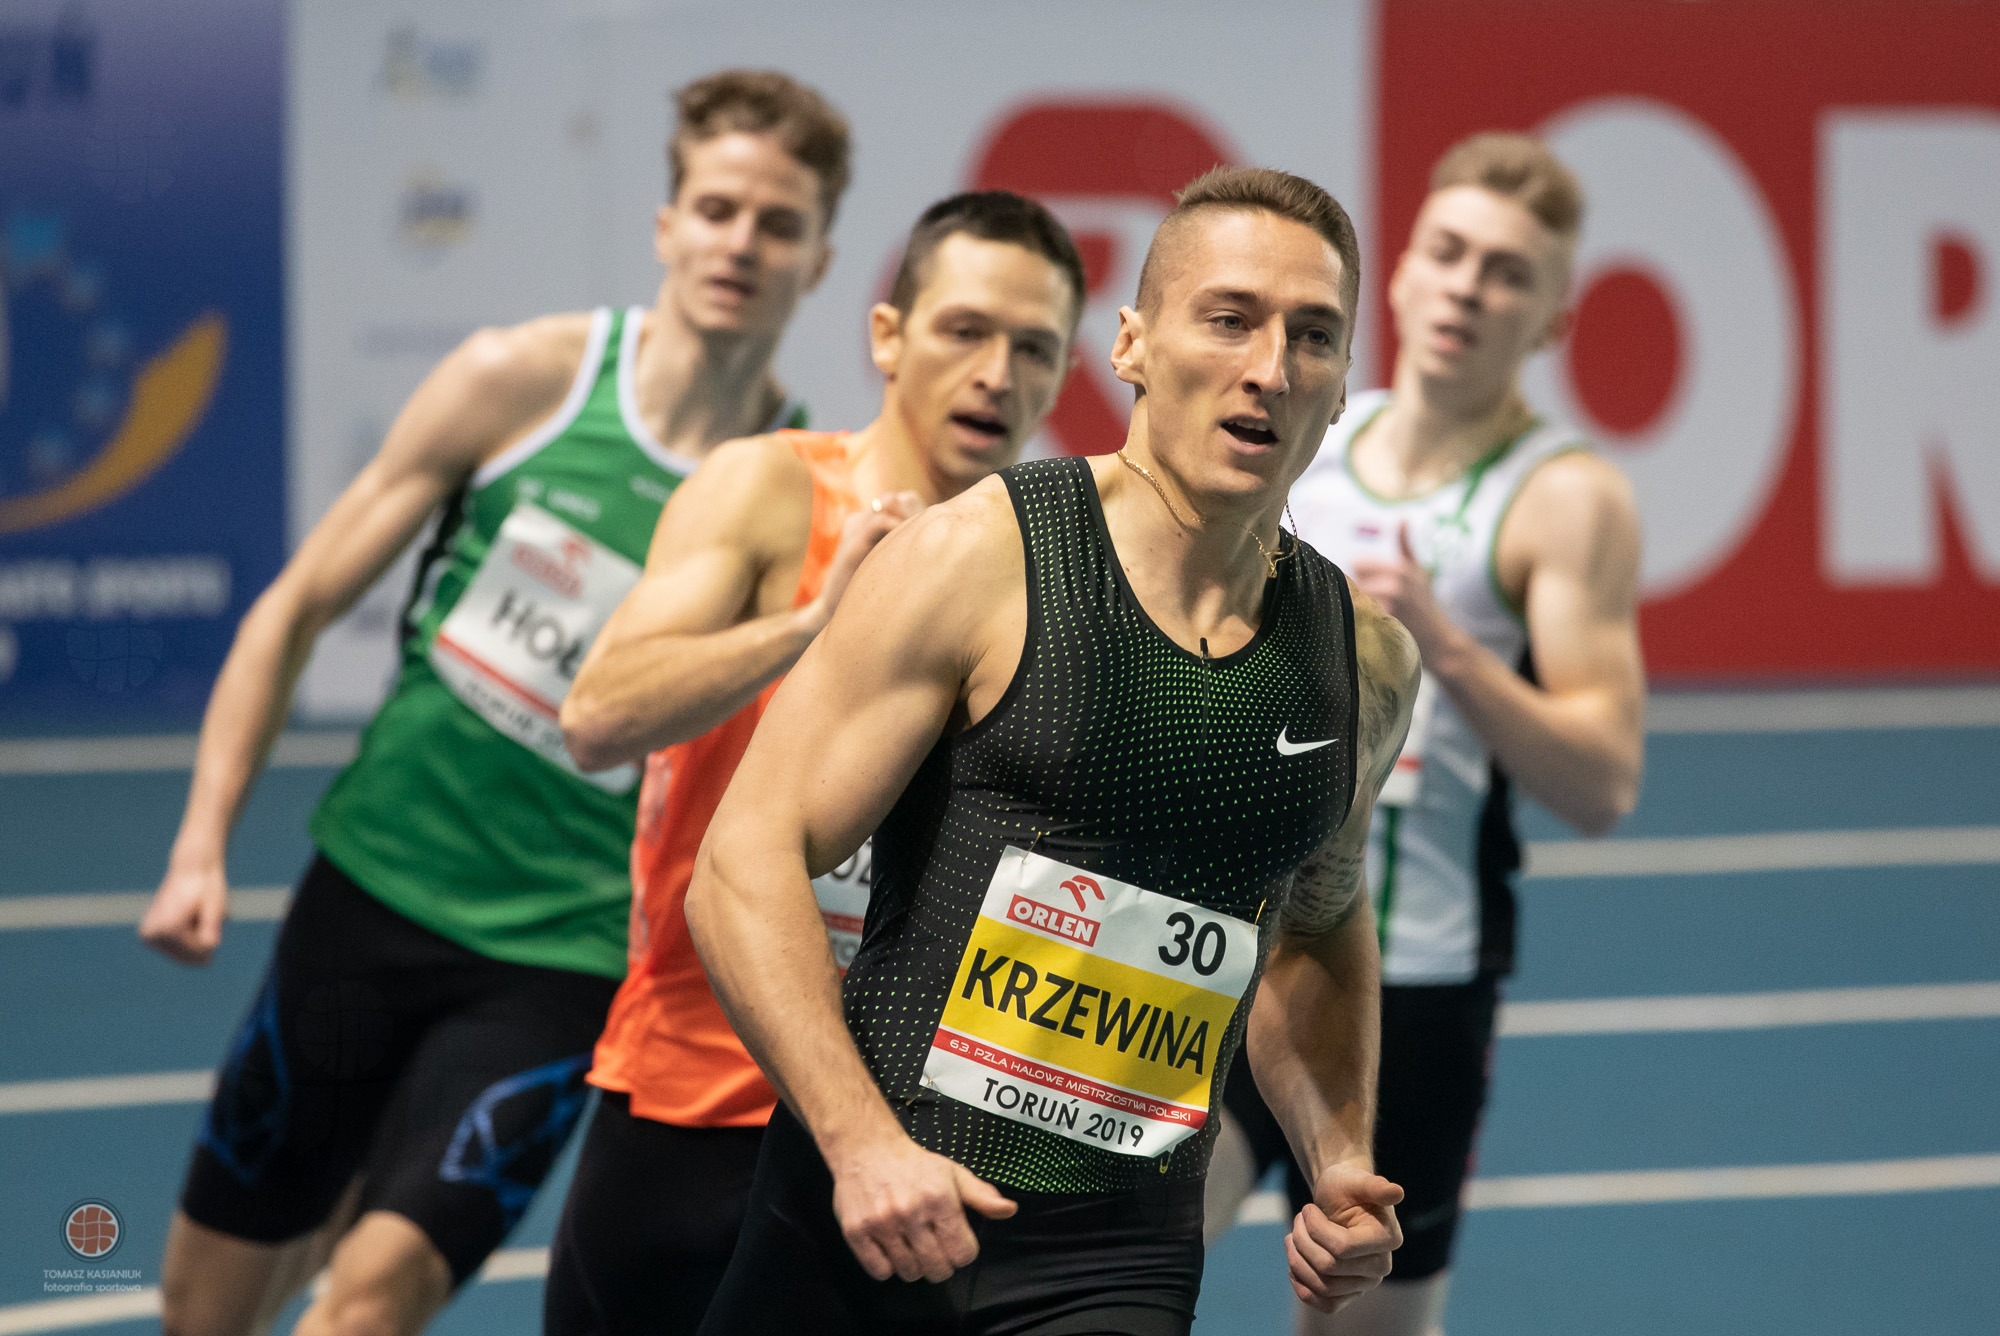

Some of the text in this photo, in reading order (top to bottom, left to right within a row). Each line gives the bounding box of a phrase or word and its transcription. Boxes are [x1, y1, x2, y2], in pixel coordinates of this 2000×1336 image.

[1012, 902, 1096, 943] ORLEN
[1157, 911, 1227, 976] 30
[960, 946, 1210, 1076] KRZEWINA
[949, 1038, 1192, 1123] 63. PZLA HALOWE MISTRZOSTWA POLSKI
[983, 1076, 1145, 1148] TORUŃ 2019
